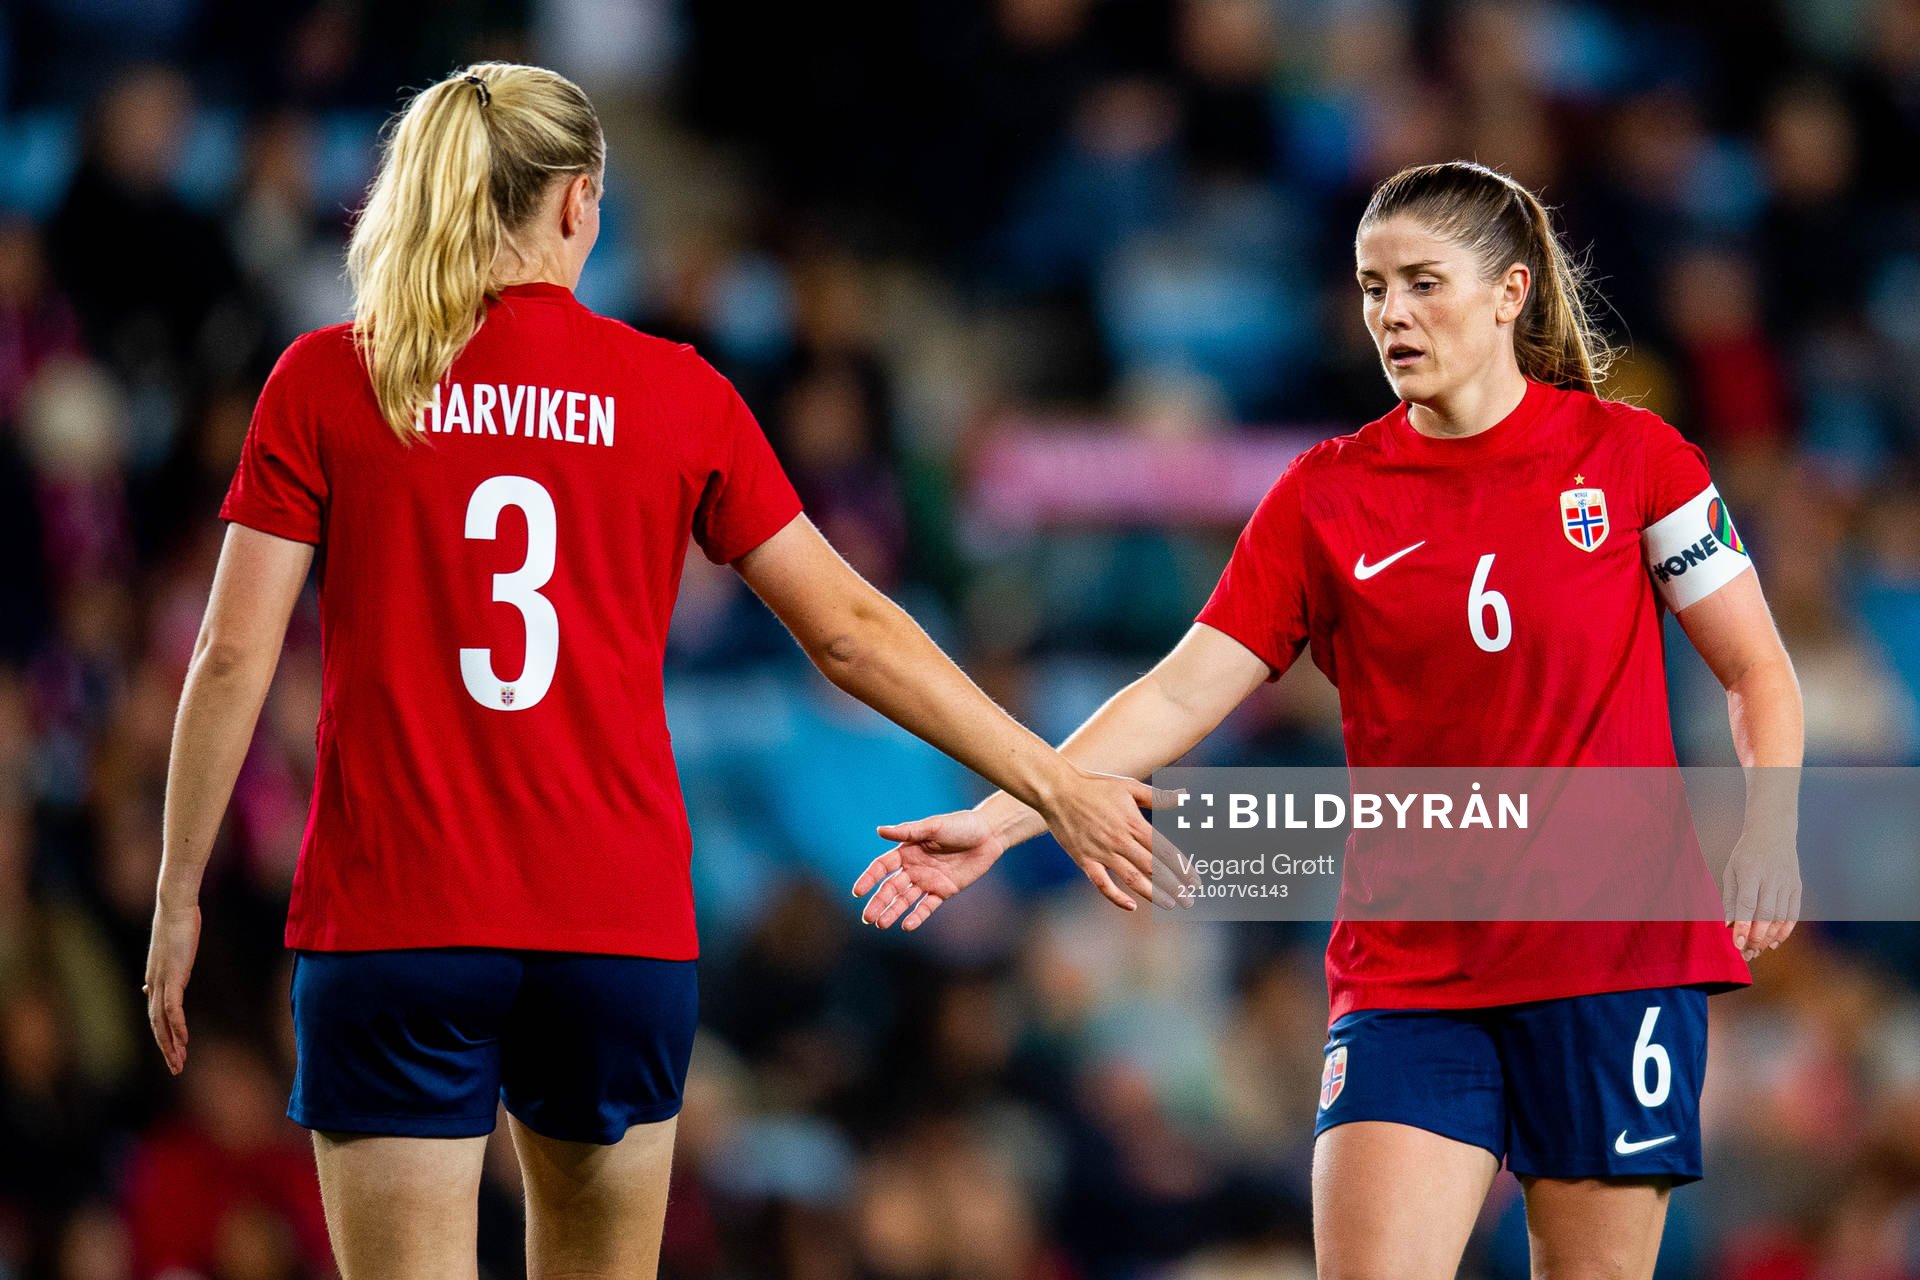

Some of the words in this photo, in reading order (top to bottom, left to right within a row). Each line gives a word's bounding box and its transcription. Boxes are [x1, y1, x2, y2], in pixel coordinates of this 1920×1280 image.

[414, 383, 615, 447] HARVIKEN
[459, 475, 560, 711] 3
[1467, 553, 1512, 653] 6
[1632, 1006, 1672, 1108] 6
